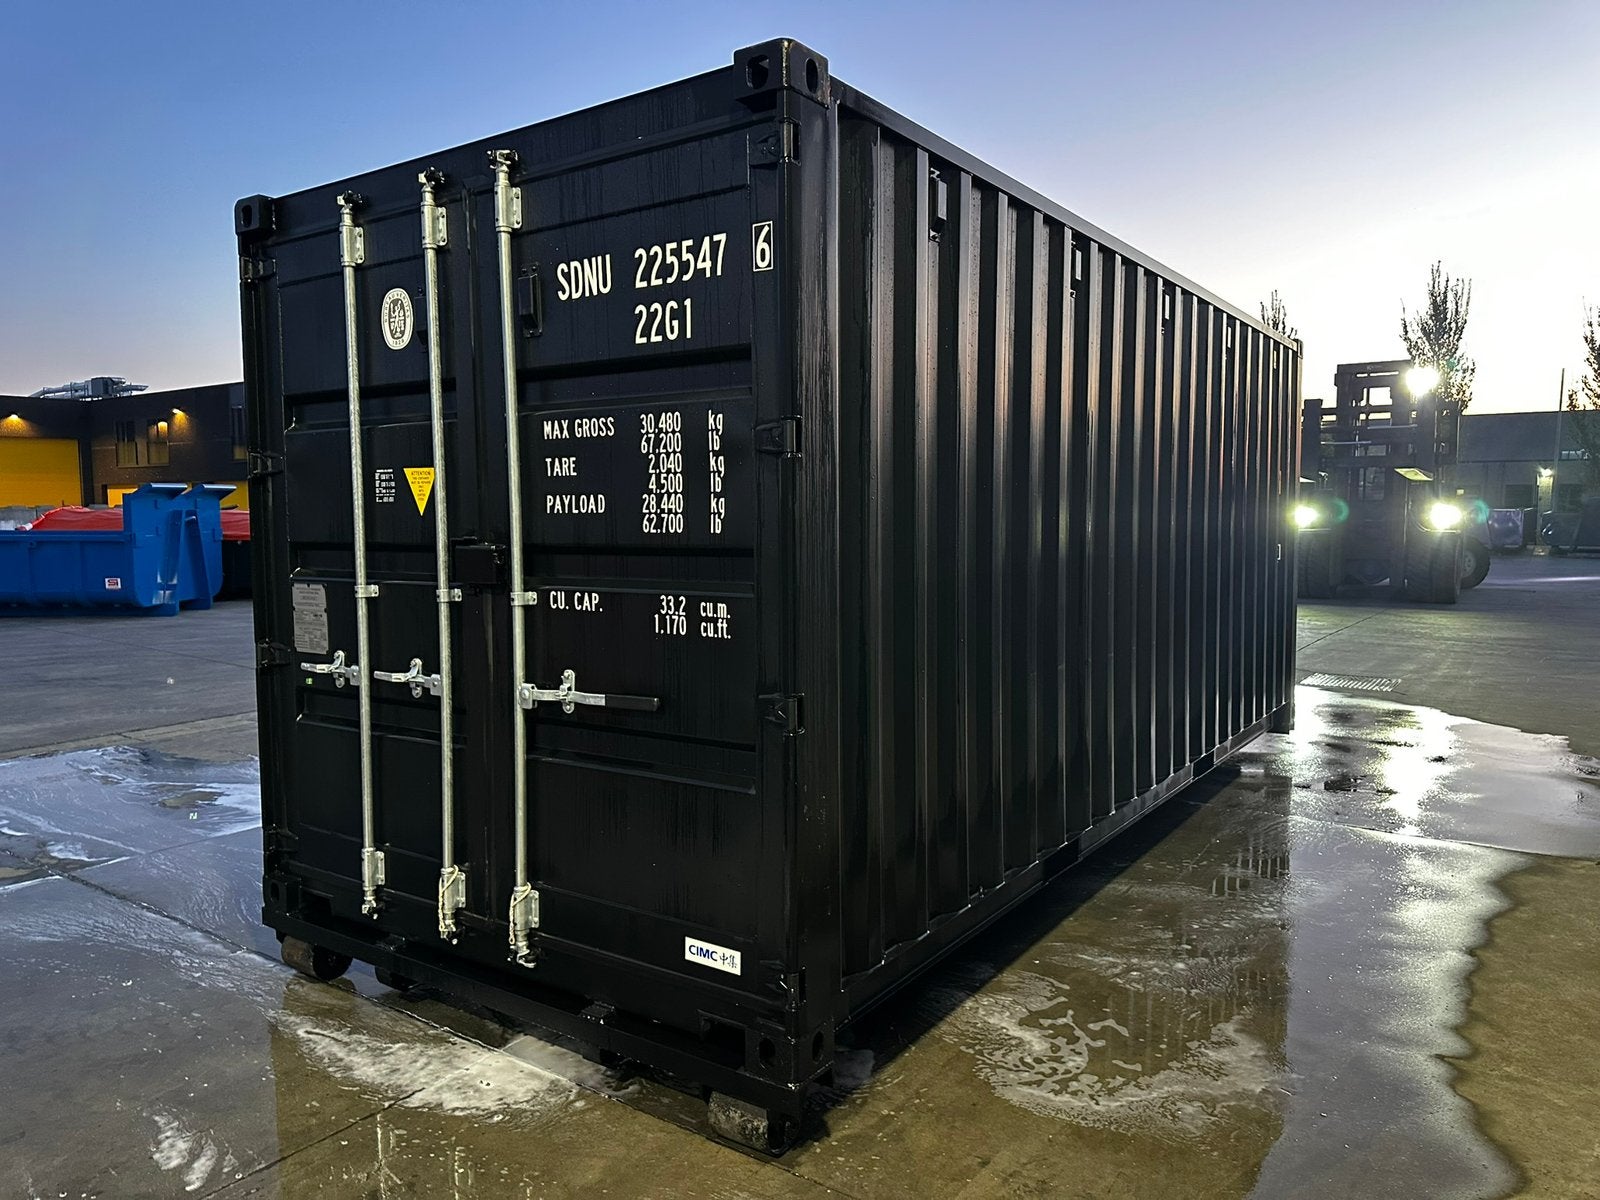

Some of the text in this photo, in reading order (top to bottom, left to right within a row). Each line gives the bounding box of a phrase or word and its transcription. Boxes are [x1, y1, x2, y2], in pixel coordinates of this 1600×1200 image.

[556, 225, 771, 301] SDNU 225547 6
[634, 297, 692, 344] 22G1
[543, 419, 570, 440] MAX
[574, 416, 615, 438] GROSS
[708, 410, 723, 436] kg
[708, 432, 720, 451] lb
[545, 456, 577, 476] TARE
[709, 452, 725, 477] kg
[710, 473, 722, 492] lb
[546, 494, 606, 514] PAYLOAD
[710, 494, 725, 520] kg
[710, 514, 722, 534] lb
[549, 590, 731, 619] CU. CAP. 33.2 cu.m.
[700, 618, 732, 640] cu.ft.
[688, 944, 718, 962] CIMC
